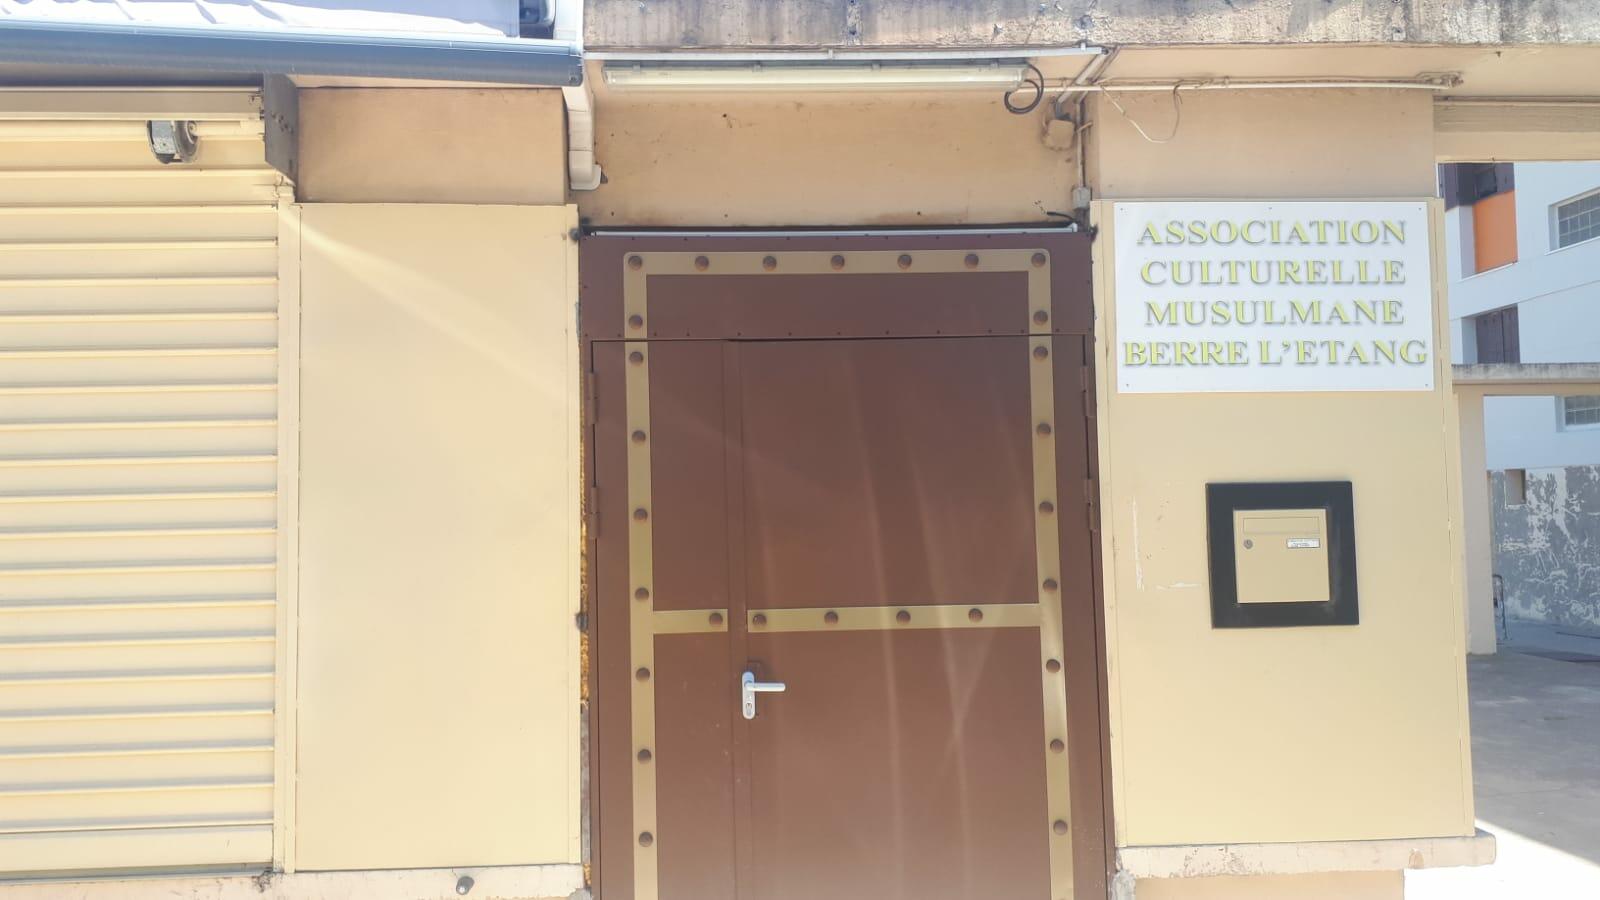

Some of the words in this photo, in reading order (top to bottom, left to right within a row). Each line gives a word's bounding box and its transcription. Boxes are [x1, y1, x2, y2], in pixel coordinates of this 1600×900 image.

[1136, 219, 1407, 245] ASSOCIATION
[1140, 260, 1407, 286] CULTURELLE
[1144, 300, 1405, 326] MUSULMANE
[1123, 340, 1250, 367] BERRE
[1257, 339, 1429, 366] L'ETANG
